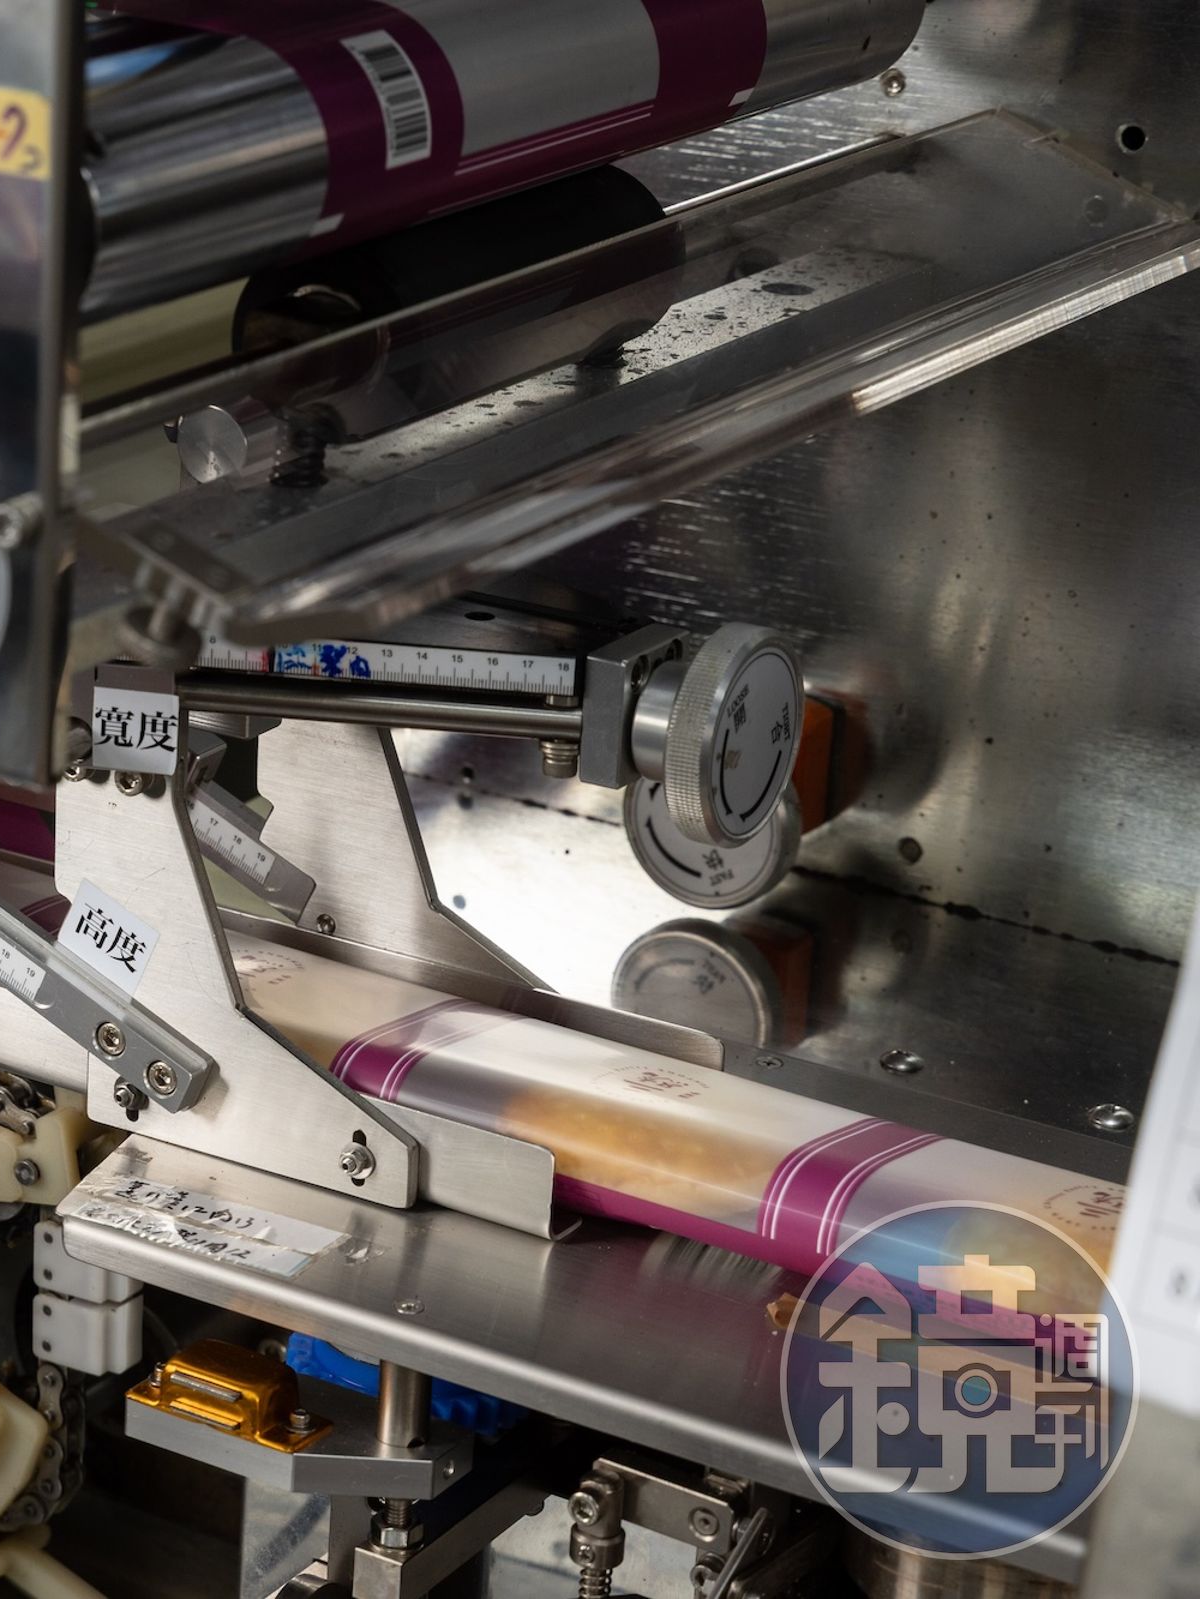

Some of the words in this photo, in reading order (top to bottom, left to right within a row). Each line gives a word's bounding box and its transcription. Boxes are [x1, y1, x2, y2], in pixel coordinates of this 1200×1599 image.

[347, 646, 358, 655] 12
[381, 649, 393, 657] 13
[416, 652, 428, 660] 14
[451, 655, 464, 663] 15
[487, 657, 499, 666] 16
[522, 660, 534, 669] 17
[558, 663, 570, 672] 18
[95, 707, 179, 752] 寬度
[210, 818, 219, 826] 17
[234, 835, 242, 845] 18
[257, 852, 266, 862] 19
[75, 903, 147, 973] 高度
[1, 948, 11, 960] 18
[26, 967, 36, 978] 19
